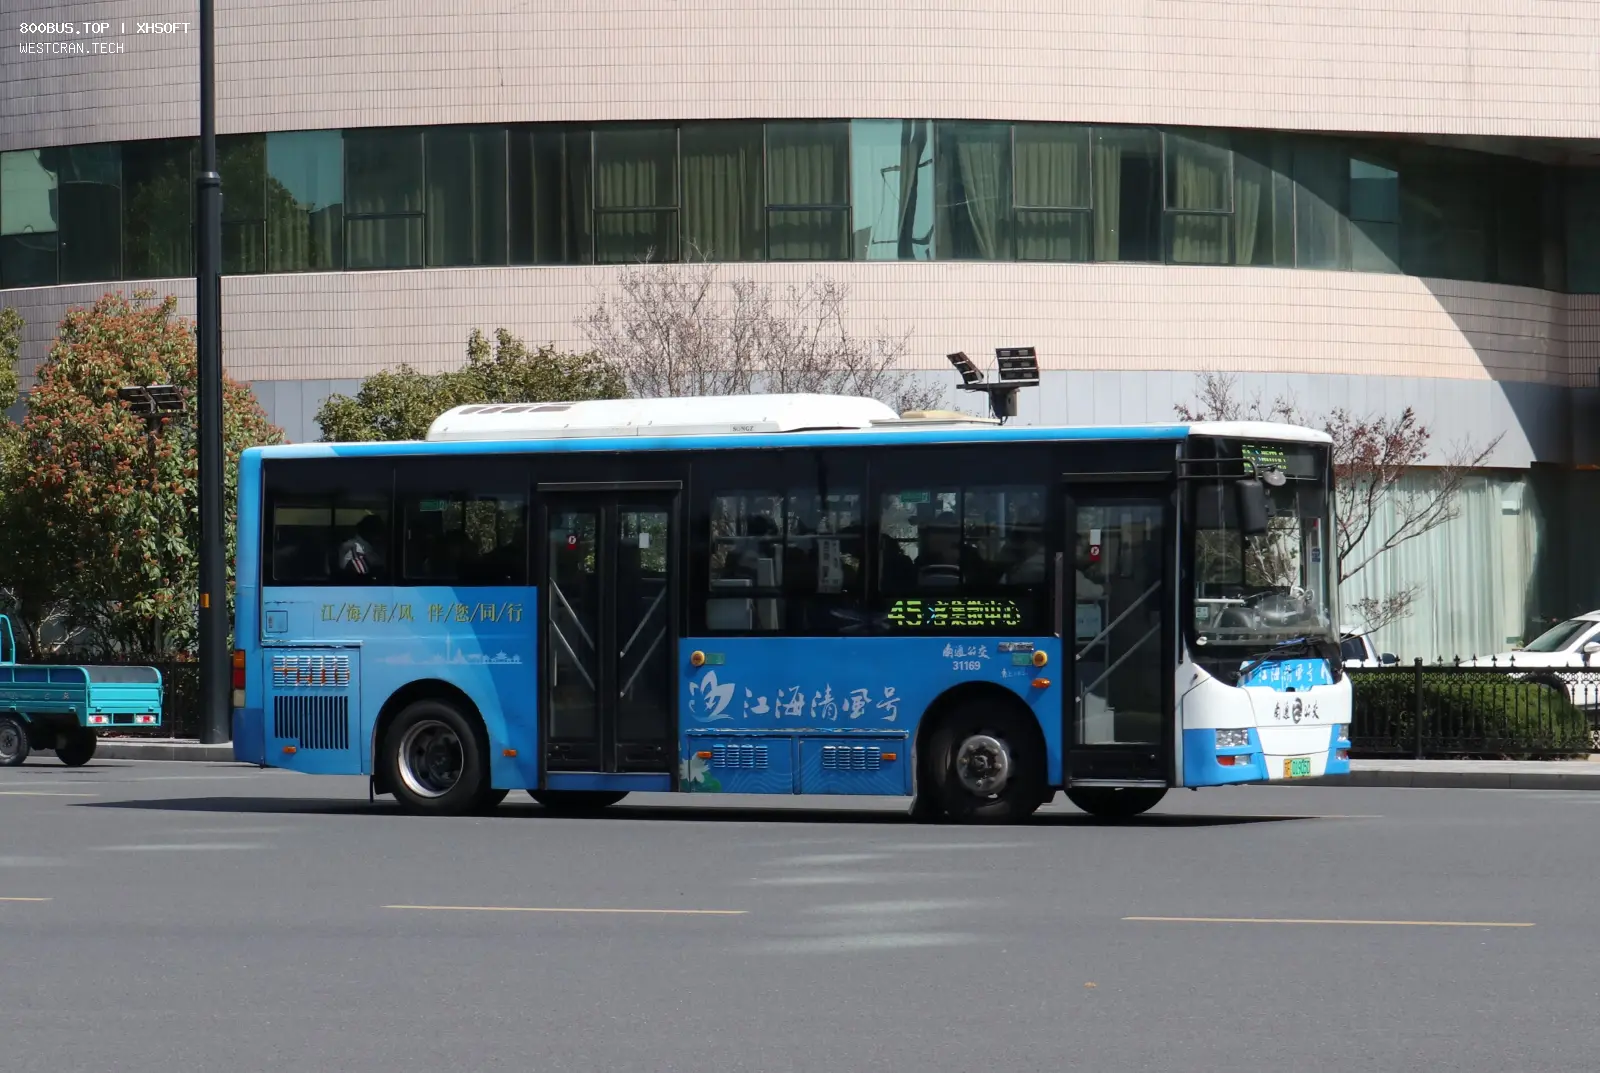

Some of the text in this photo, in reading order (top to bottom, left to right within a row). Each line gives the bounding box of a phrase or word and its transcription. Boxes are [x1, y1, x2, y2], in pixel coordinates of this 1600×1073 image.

[887, 600, 922, 626] 45
[942, 642, 990, 660] 南通公交
[952, 660, 981, 671] 31169
